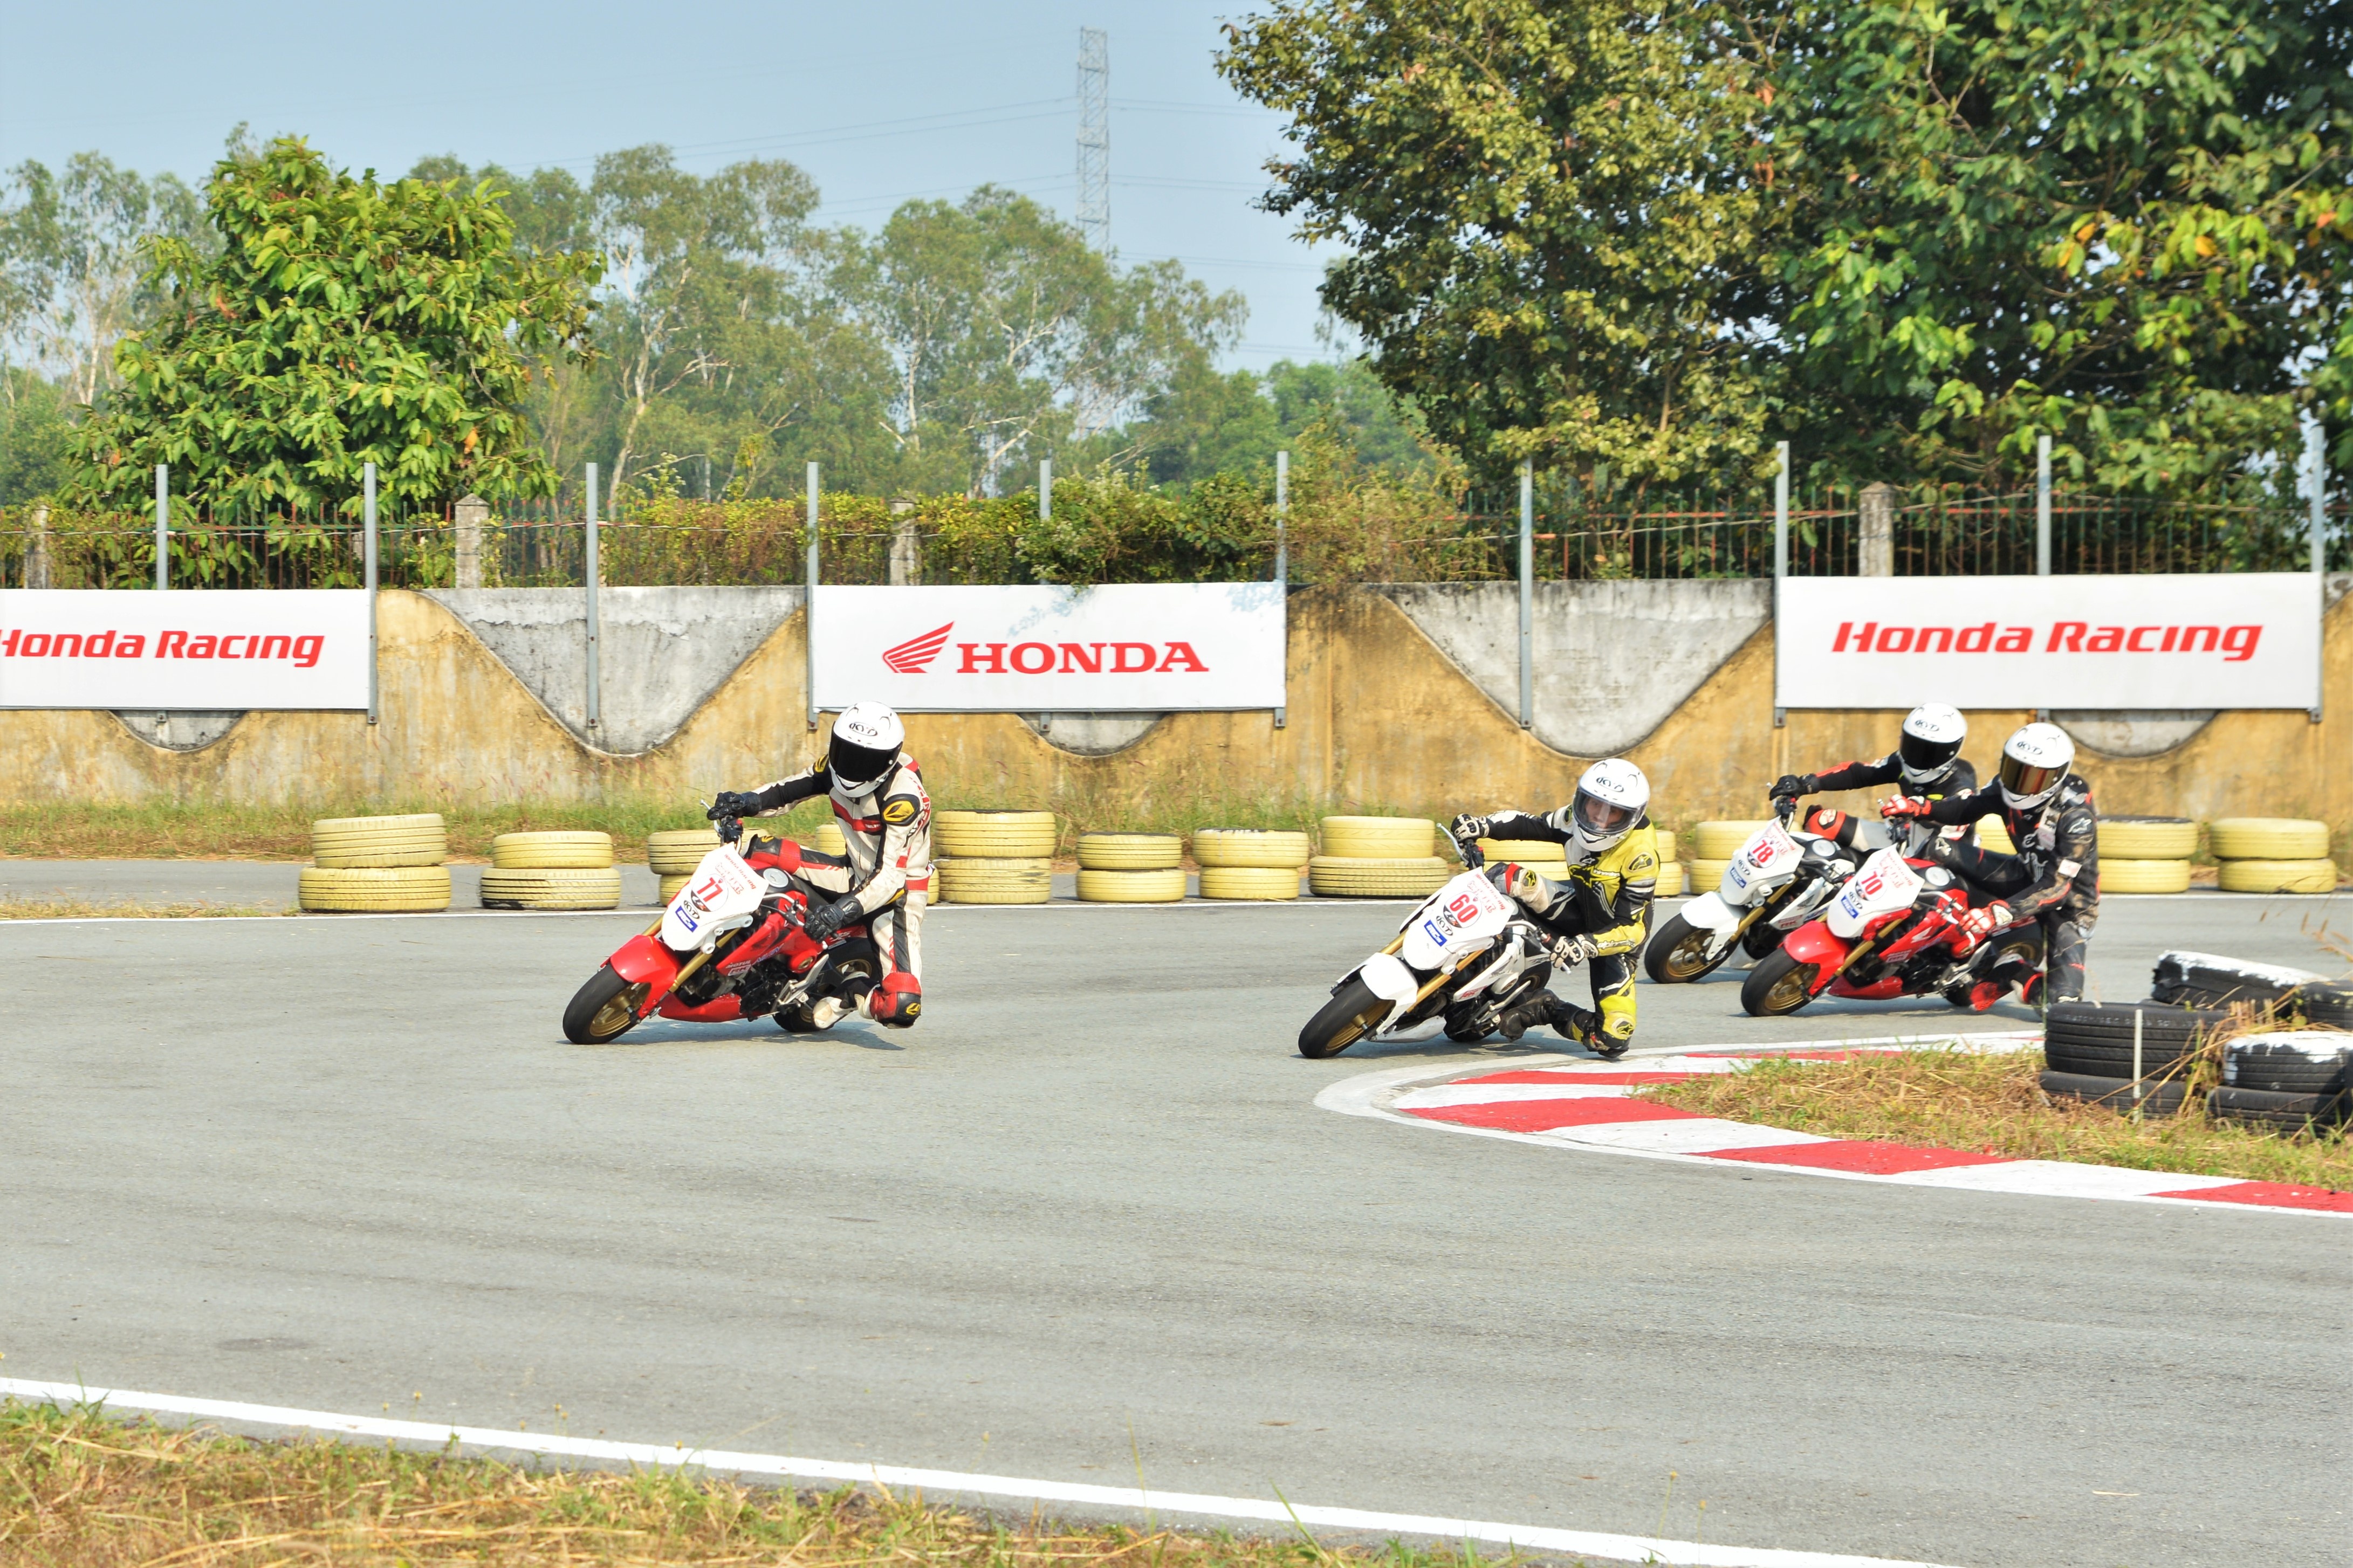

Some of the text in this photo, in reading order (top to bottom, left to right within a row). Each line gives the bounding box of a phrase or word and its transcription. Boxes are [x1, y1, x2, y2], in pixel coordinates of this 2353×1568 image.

[155, 630, 325, 668] Racing
[957, 642, 1210, 675] HONDA
[1832, 621, 2264, 662] Honda Racing
[1449, 894, 1478, 923] 60
